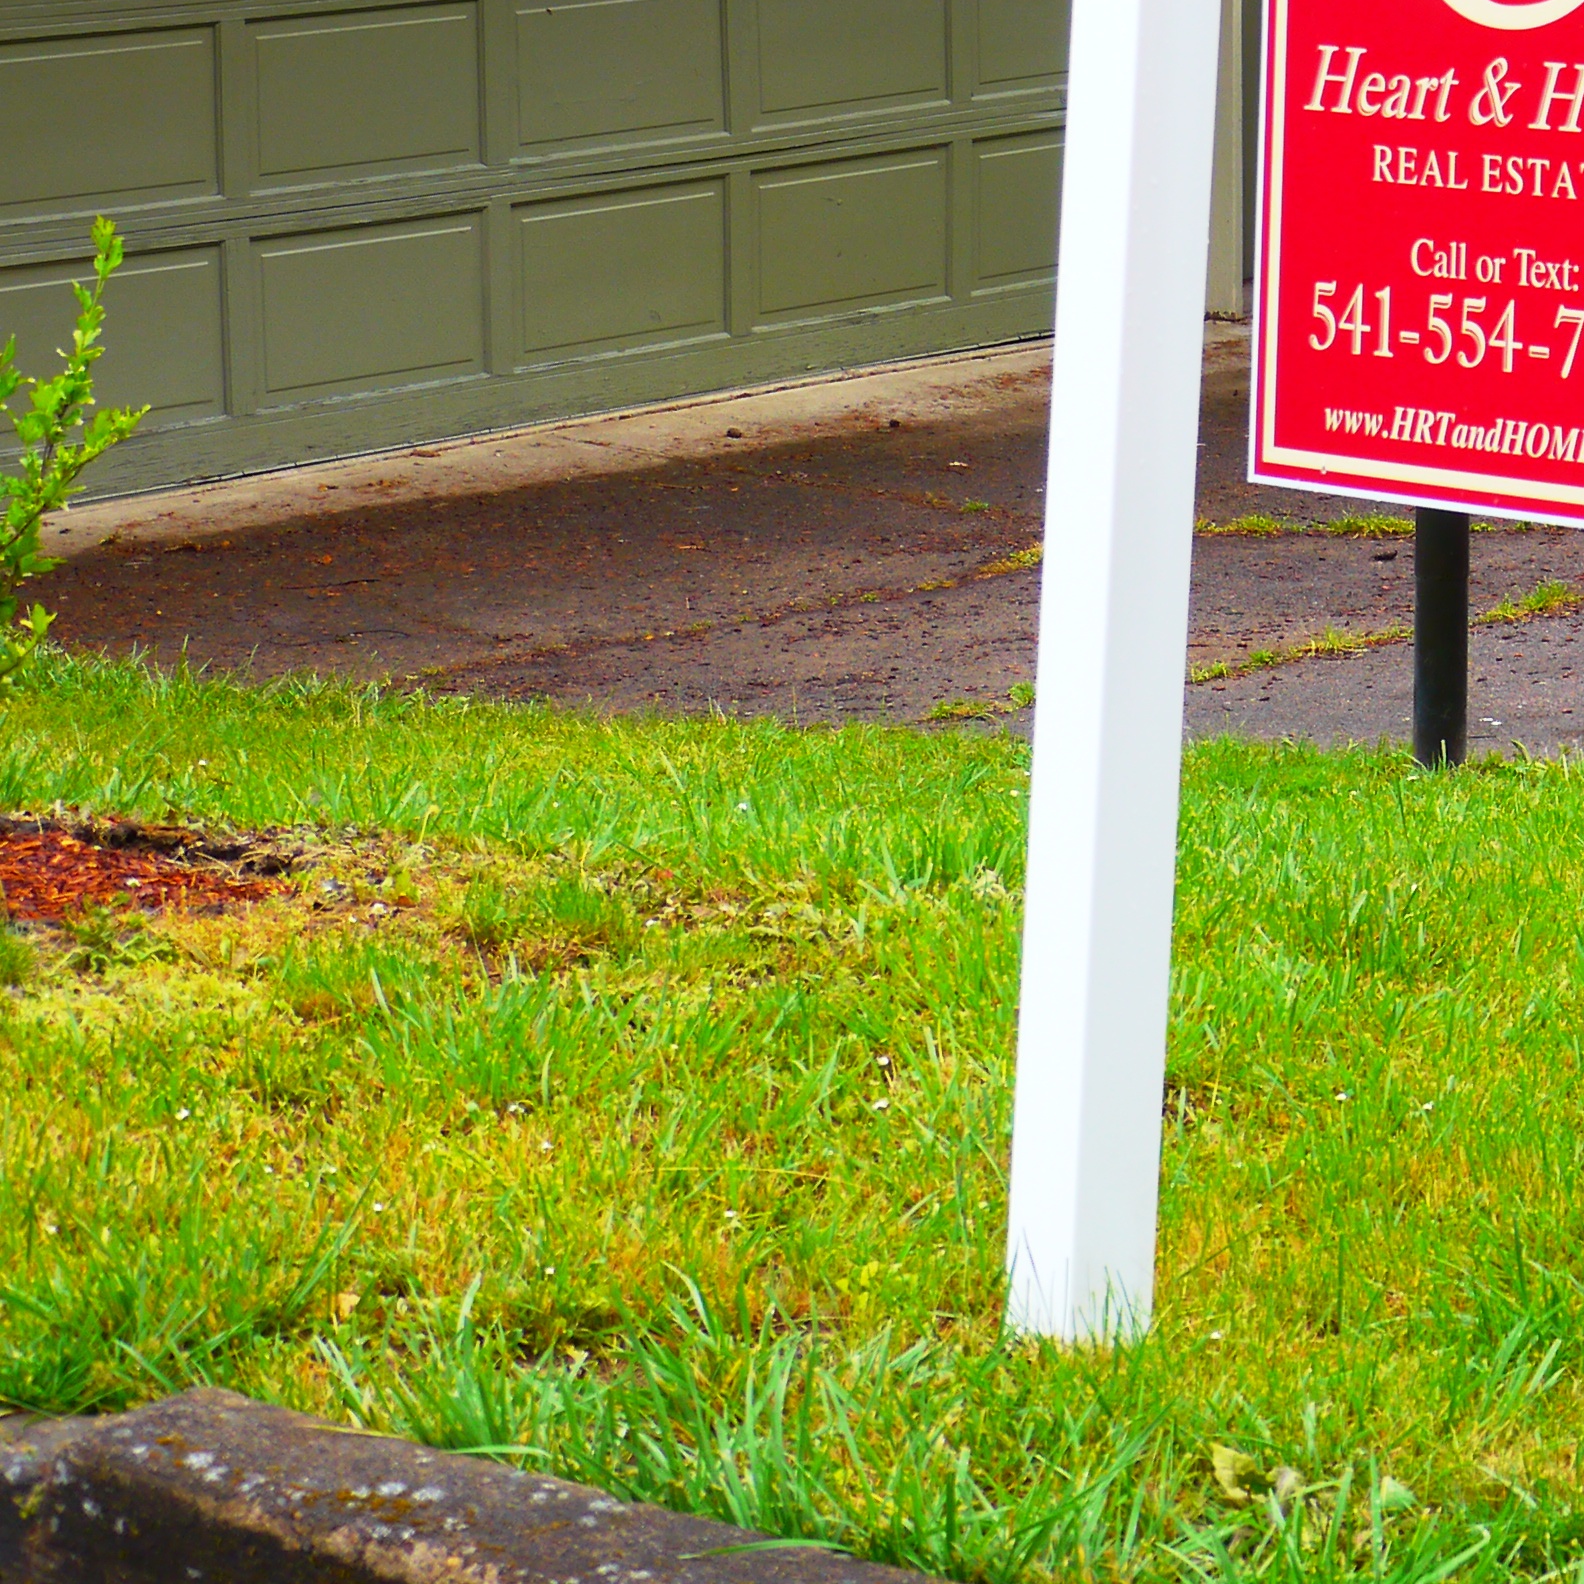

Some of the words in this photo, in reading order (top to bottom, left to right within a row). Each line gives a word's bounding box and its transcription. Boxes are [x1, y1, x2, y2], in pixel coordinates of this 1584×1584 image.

[1304, 44, 1459, 122] Heart
[1469, 56, 1521, 127] &
[1372, 144, 1468, 189] REAL
[1410, 238, 1466, 280] Call
[1476, 256, 1506, 284] or
[1513, 248, 1580, 292] Text:
